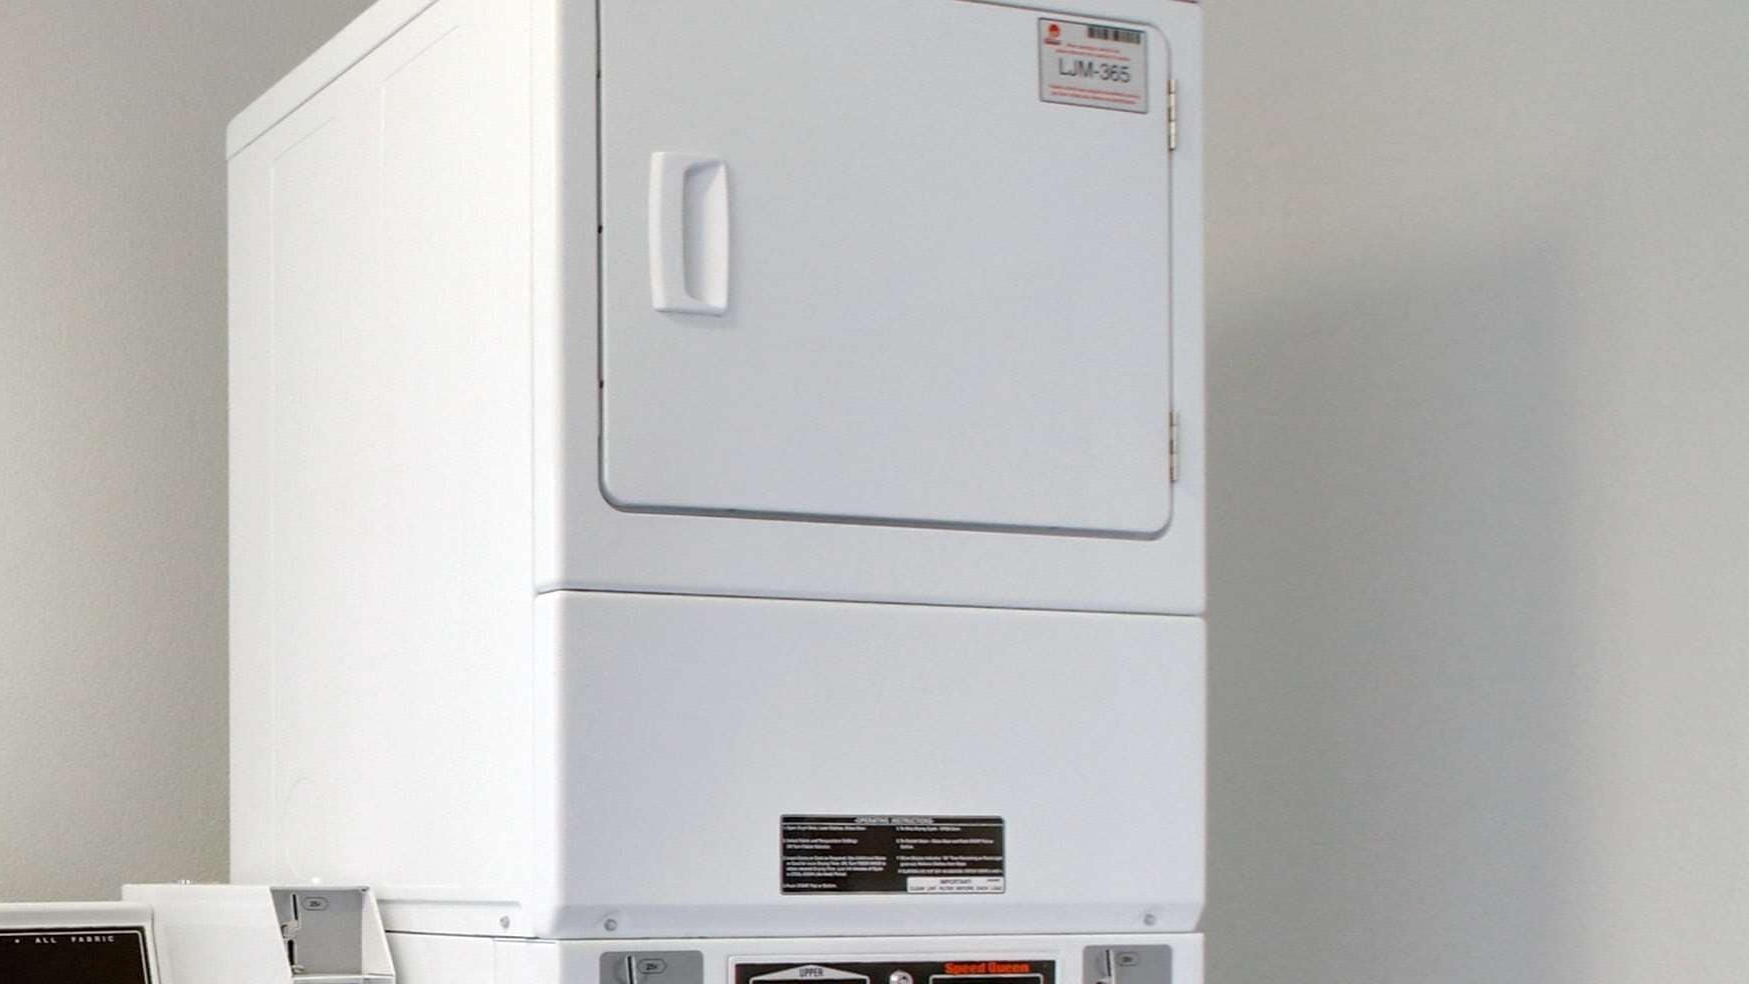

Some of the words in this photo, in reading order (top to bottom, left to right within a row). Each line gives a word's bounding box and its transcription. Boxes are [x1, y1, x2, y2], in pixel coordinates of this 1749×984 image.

[1058, 57, 1131, 83] LJM-365
[35, 936, 57, 944] ALL
[71, 935, 114, 943] FABRIC
[799, 968, 824, 977] UPPER
[945, 963, 986, 975] Speed
[988, 962, 1030, 973] Queen
